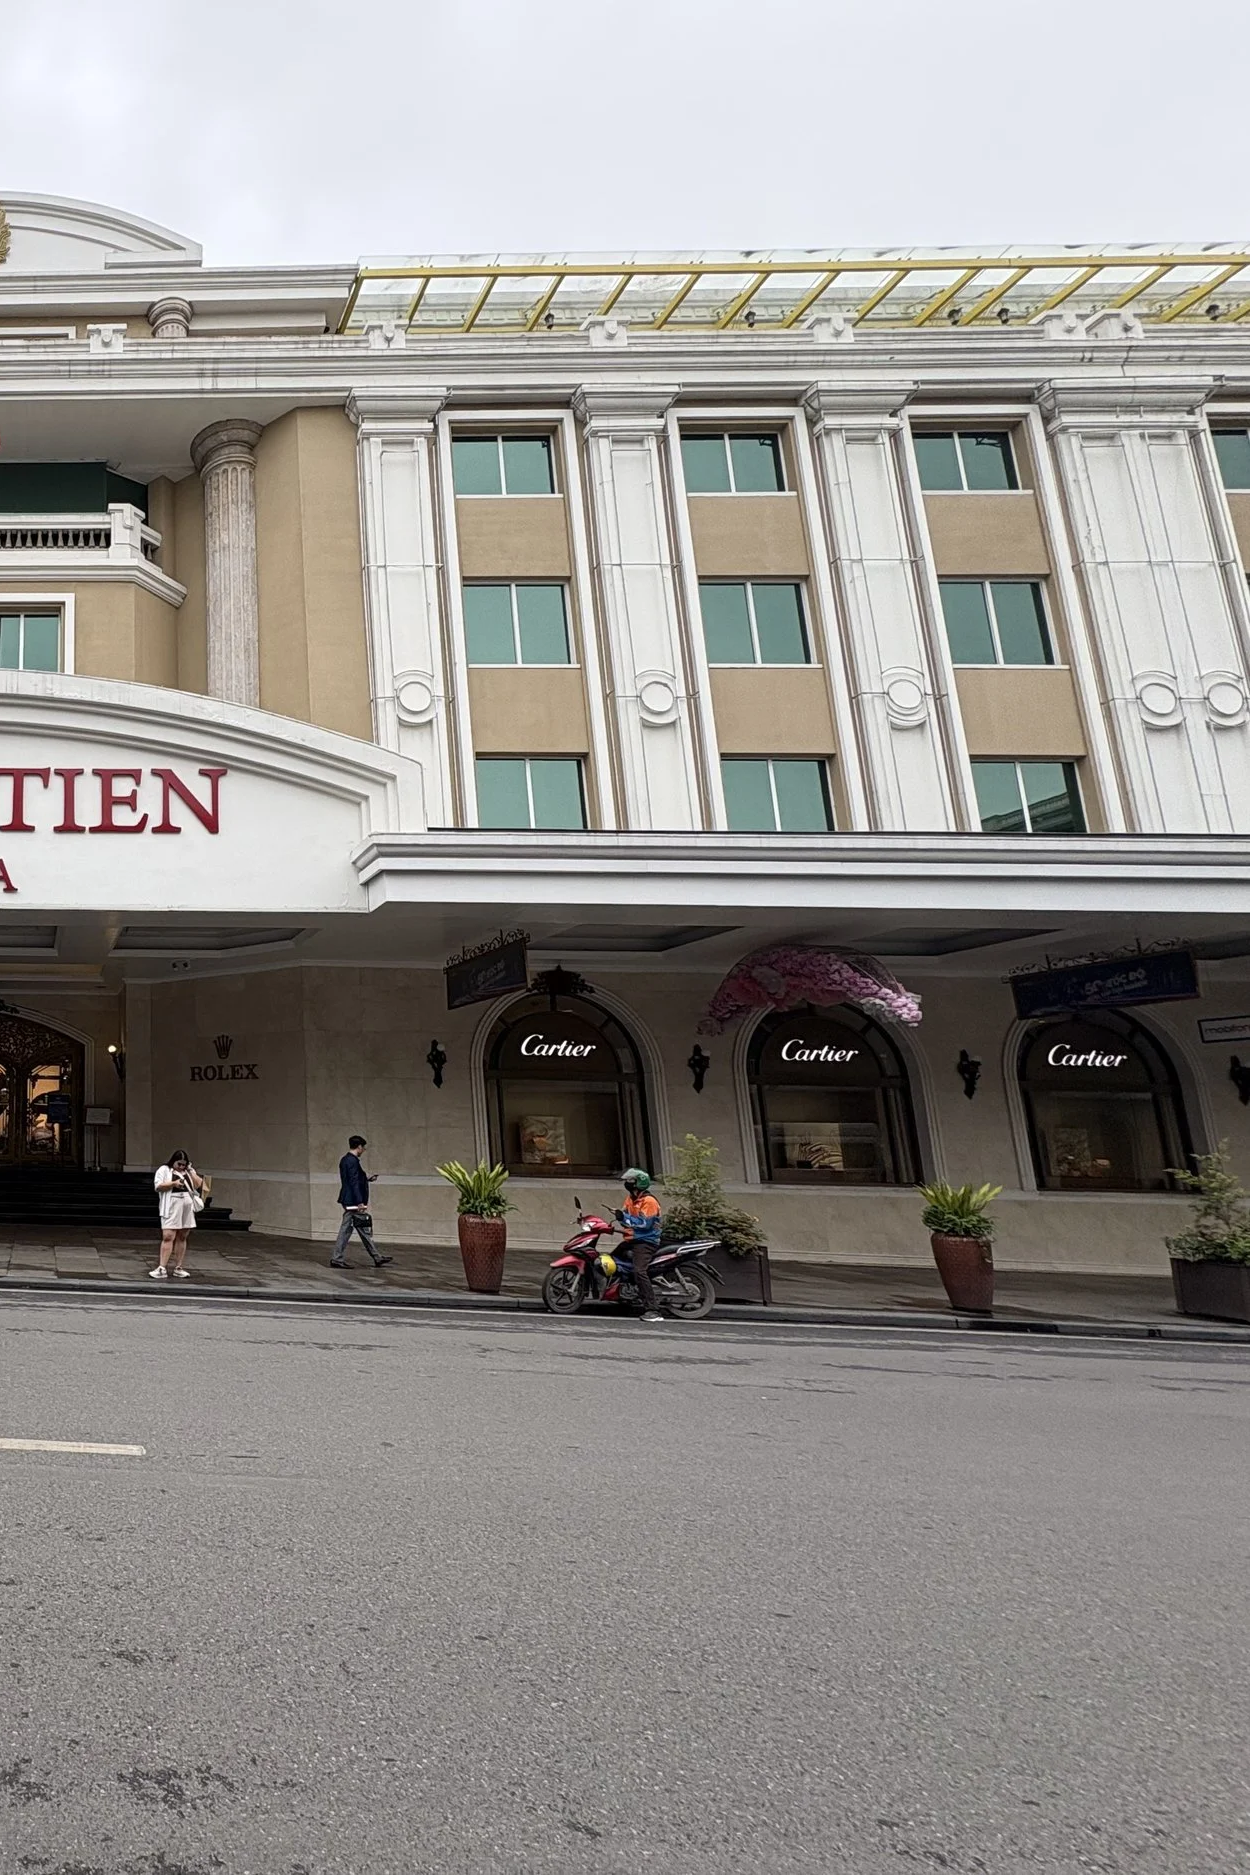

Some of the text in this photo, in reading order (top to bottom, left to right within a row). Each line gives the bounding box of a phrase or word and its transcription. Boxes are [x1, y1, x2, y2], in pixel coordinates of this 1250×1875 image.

[520, 1033, 596, 1058] Cartier
[781, 1038, 859, 1063] Cartier
[1047, 1043, 1128, 1068] Cartier
[189, 1062, 260, 1082] ROLEX
